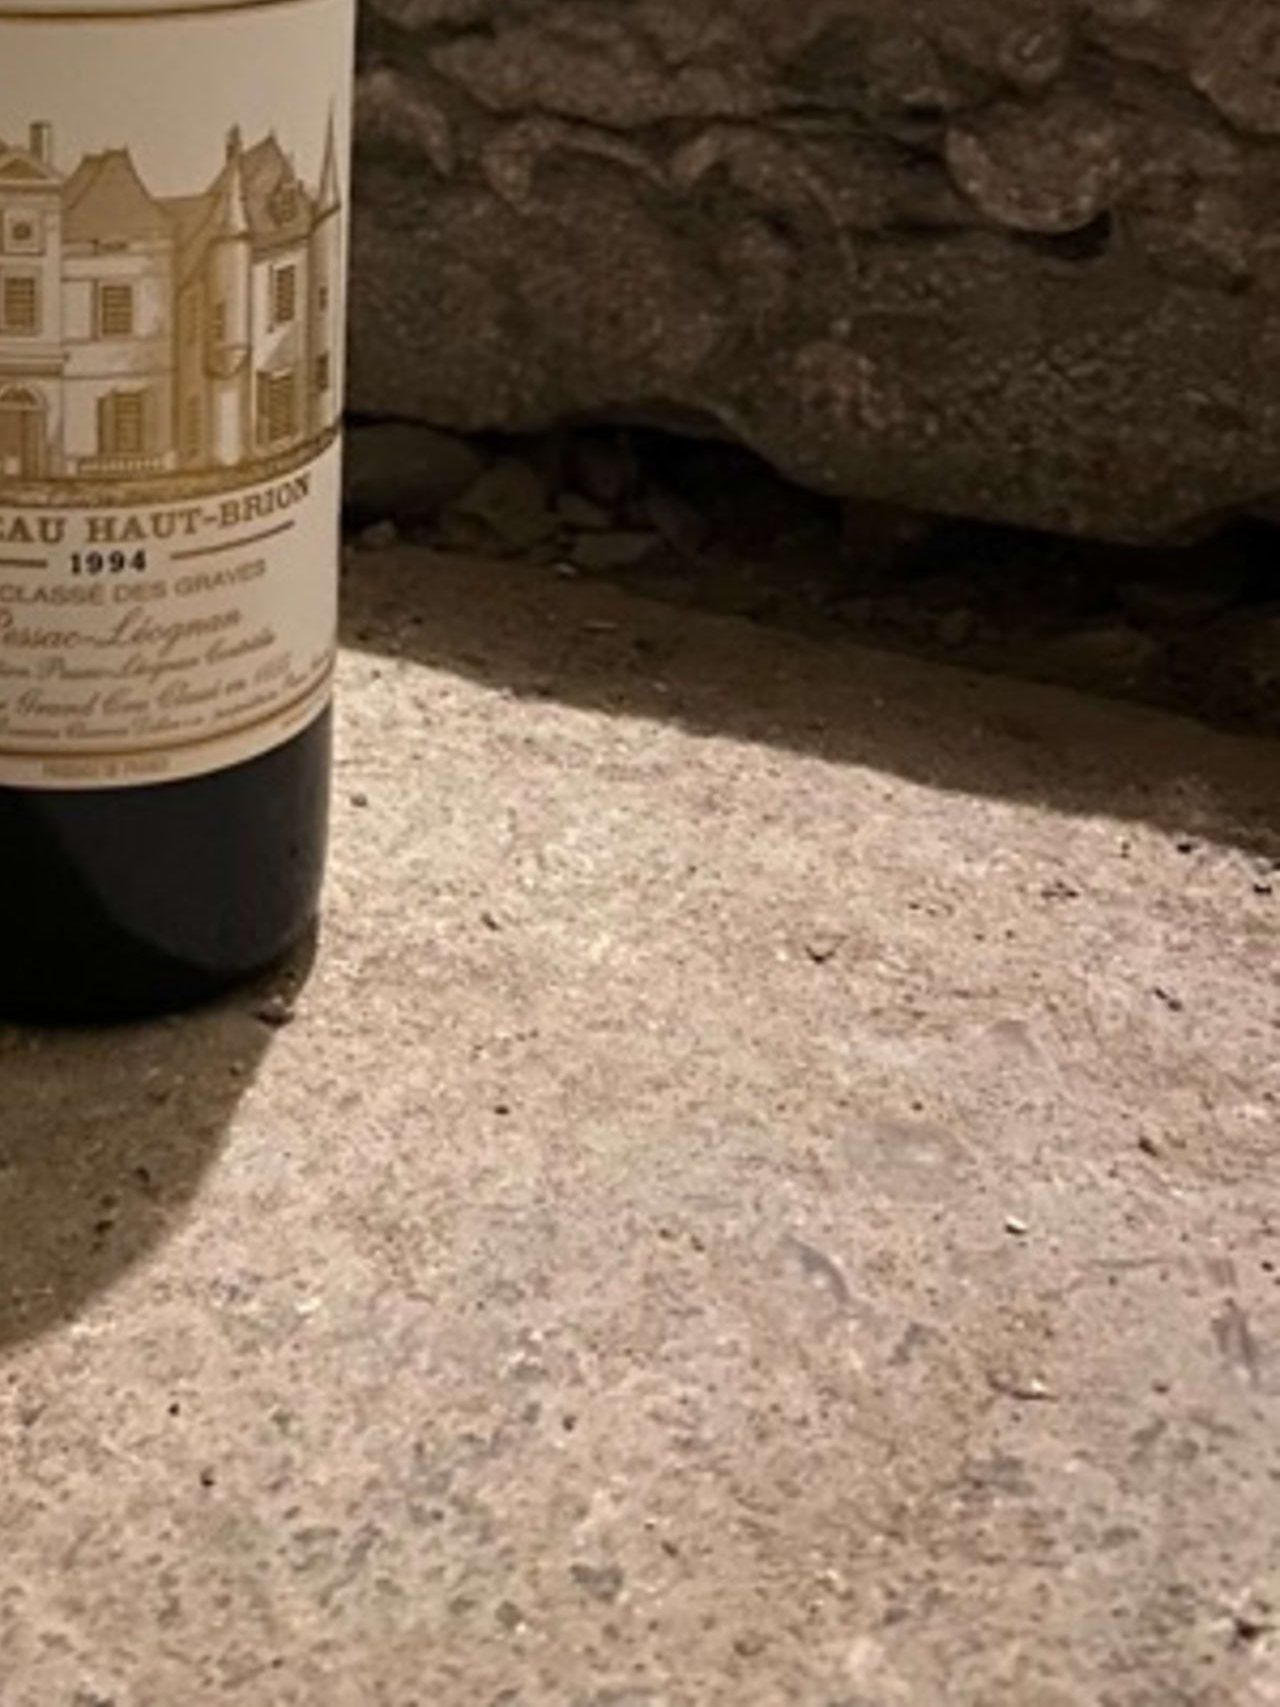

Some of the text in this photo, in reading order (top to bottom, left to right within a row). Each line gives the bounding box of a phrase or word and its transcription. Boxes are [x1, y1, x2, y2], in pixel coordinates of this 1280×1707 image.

[85, 471, 312, 544] HAUT-BRION
[69, 549, 147, 575] 1994
[111, 580, 168, 604] DES
[174, 558, 267, 598] GRAVES
